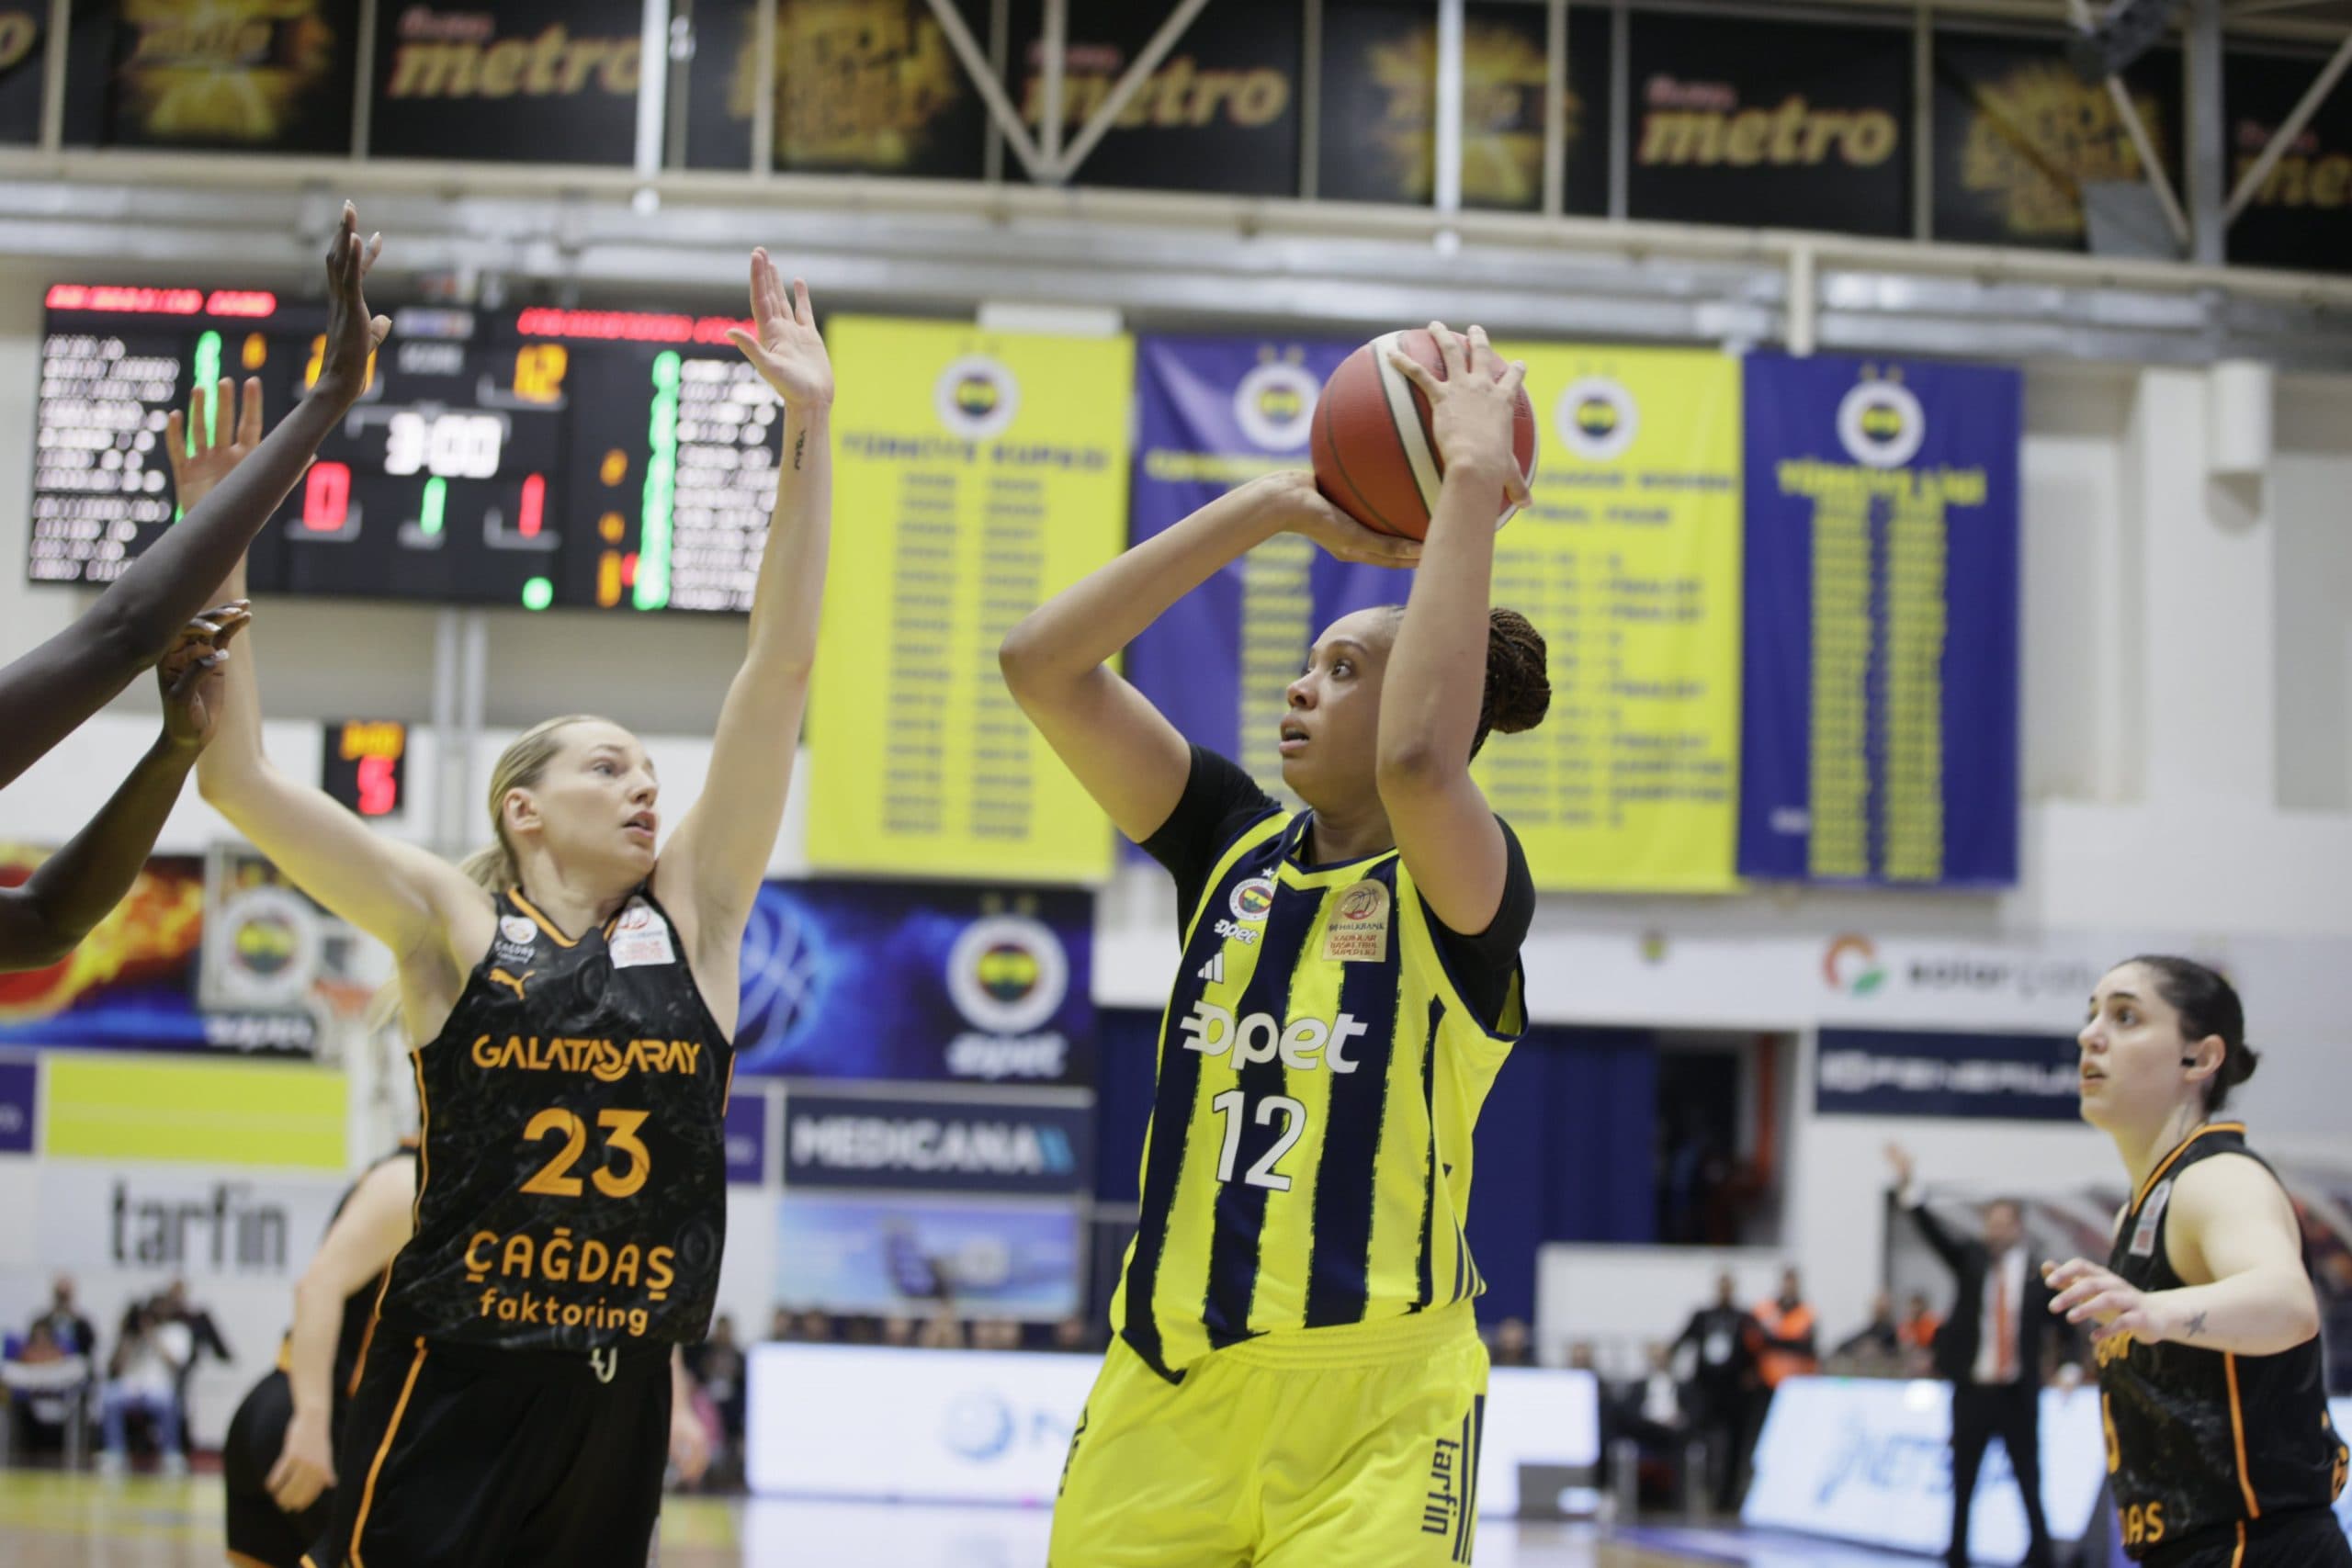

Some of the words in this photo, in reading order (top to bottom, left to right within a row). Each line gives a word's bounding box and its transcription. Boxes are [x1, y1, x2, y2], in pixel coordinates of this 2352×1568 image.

[1638, 96, 1898, 167] metro
[303, 461, 351, 532] 0
[1214, 919, 1259, 944] opet
[471, 1034, 701, 1082] GALATASARAY
[1180, 999, 1368, 1074] opet
[518, 1108, 651, 1199] 23
[791, 1117, 1040, 1173] MEDICANA
[1212, 1089, 1306, 1192] 12
[112, 1179, 288, 1268] tarfin
[464, 1227, 675, 1301] ÇAĞDAŞ
[480, 1288, 649, 1337] faktoring
[1421, 1438, 1460, 1536] tarfin
